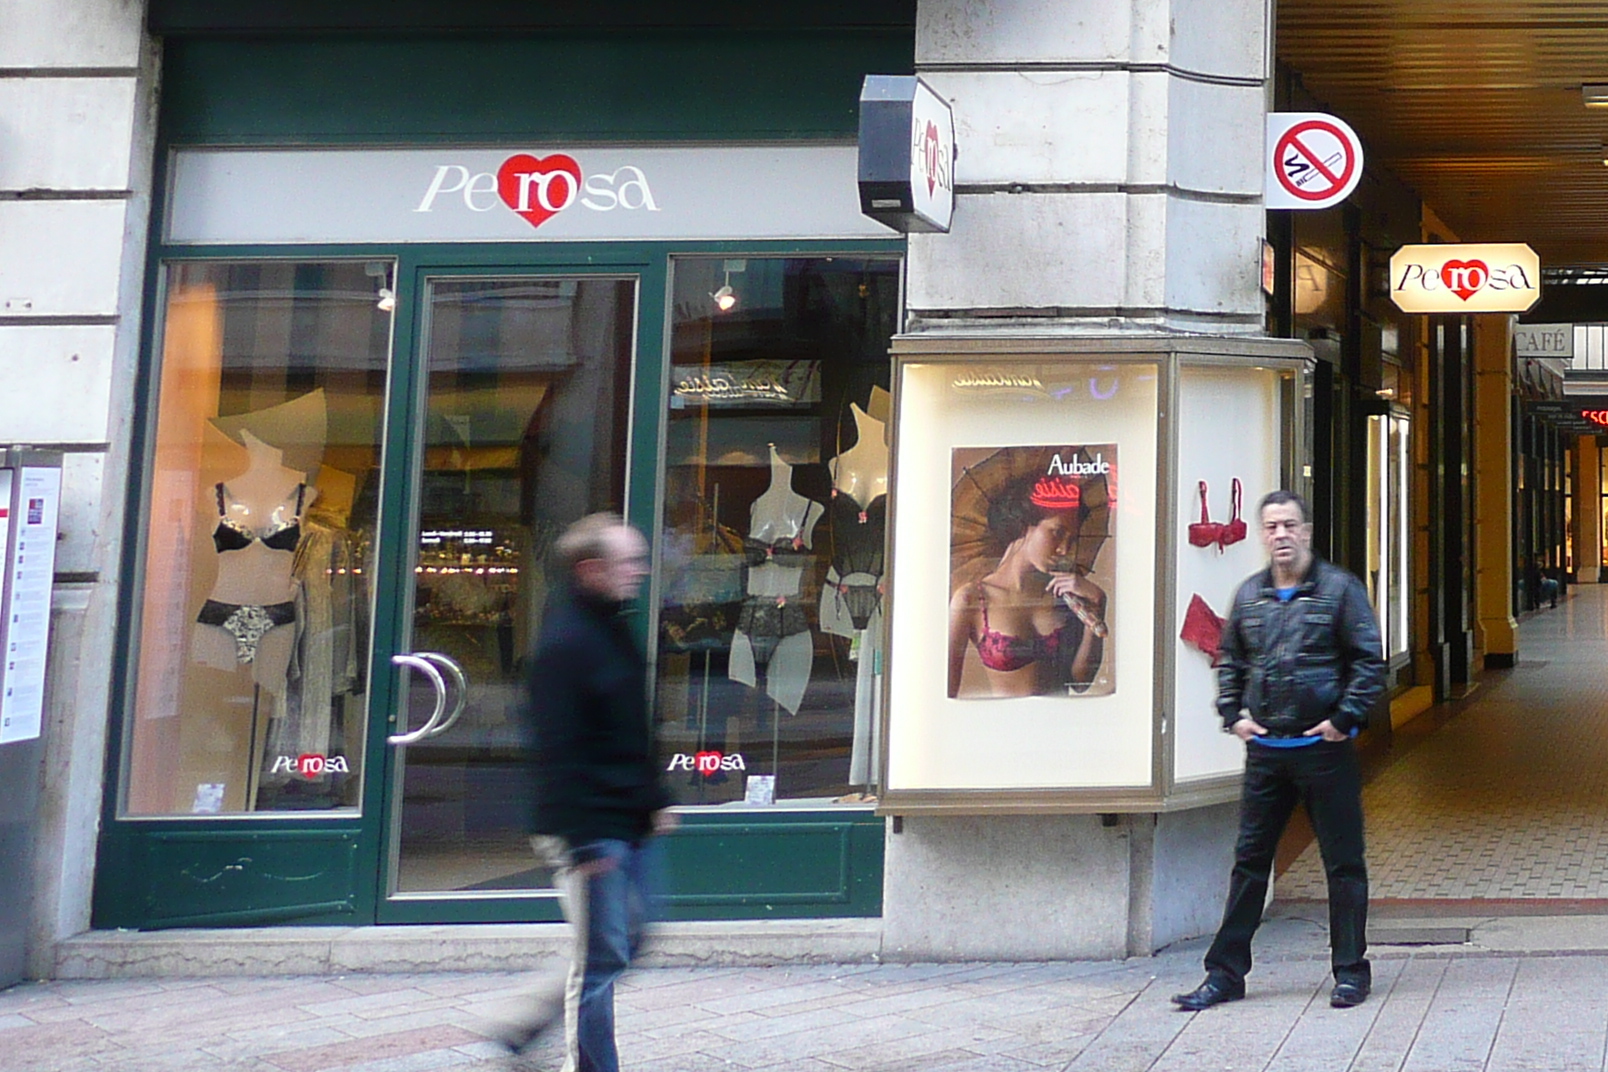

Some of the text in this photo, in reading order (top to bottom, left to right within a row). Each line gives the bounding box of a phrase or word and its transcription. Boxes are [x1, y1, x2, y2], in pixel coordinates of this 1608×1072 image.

[911, 116, 952, 192] Perosa
[412, 164, 662, 213] Perosa
[1393, 263, 1536, 293] Perosa
[1515, 329, 1566, 353] CAFÉ
[1047, 452, 1111, 475] Aubade
[269, 755, 350, 774] Perosa
[665, 753, 746, 771] Perosa
